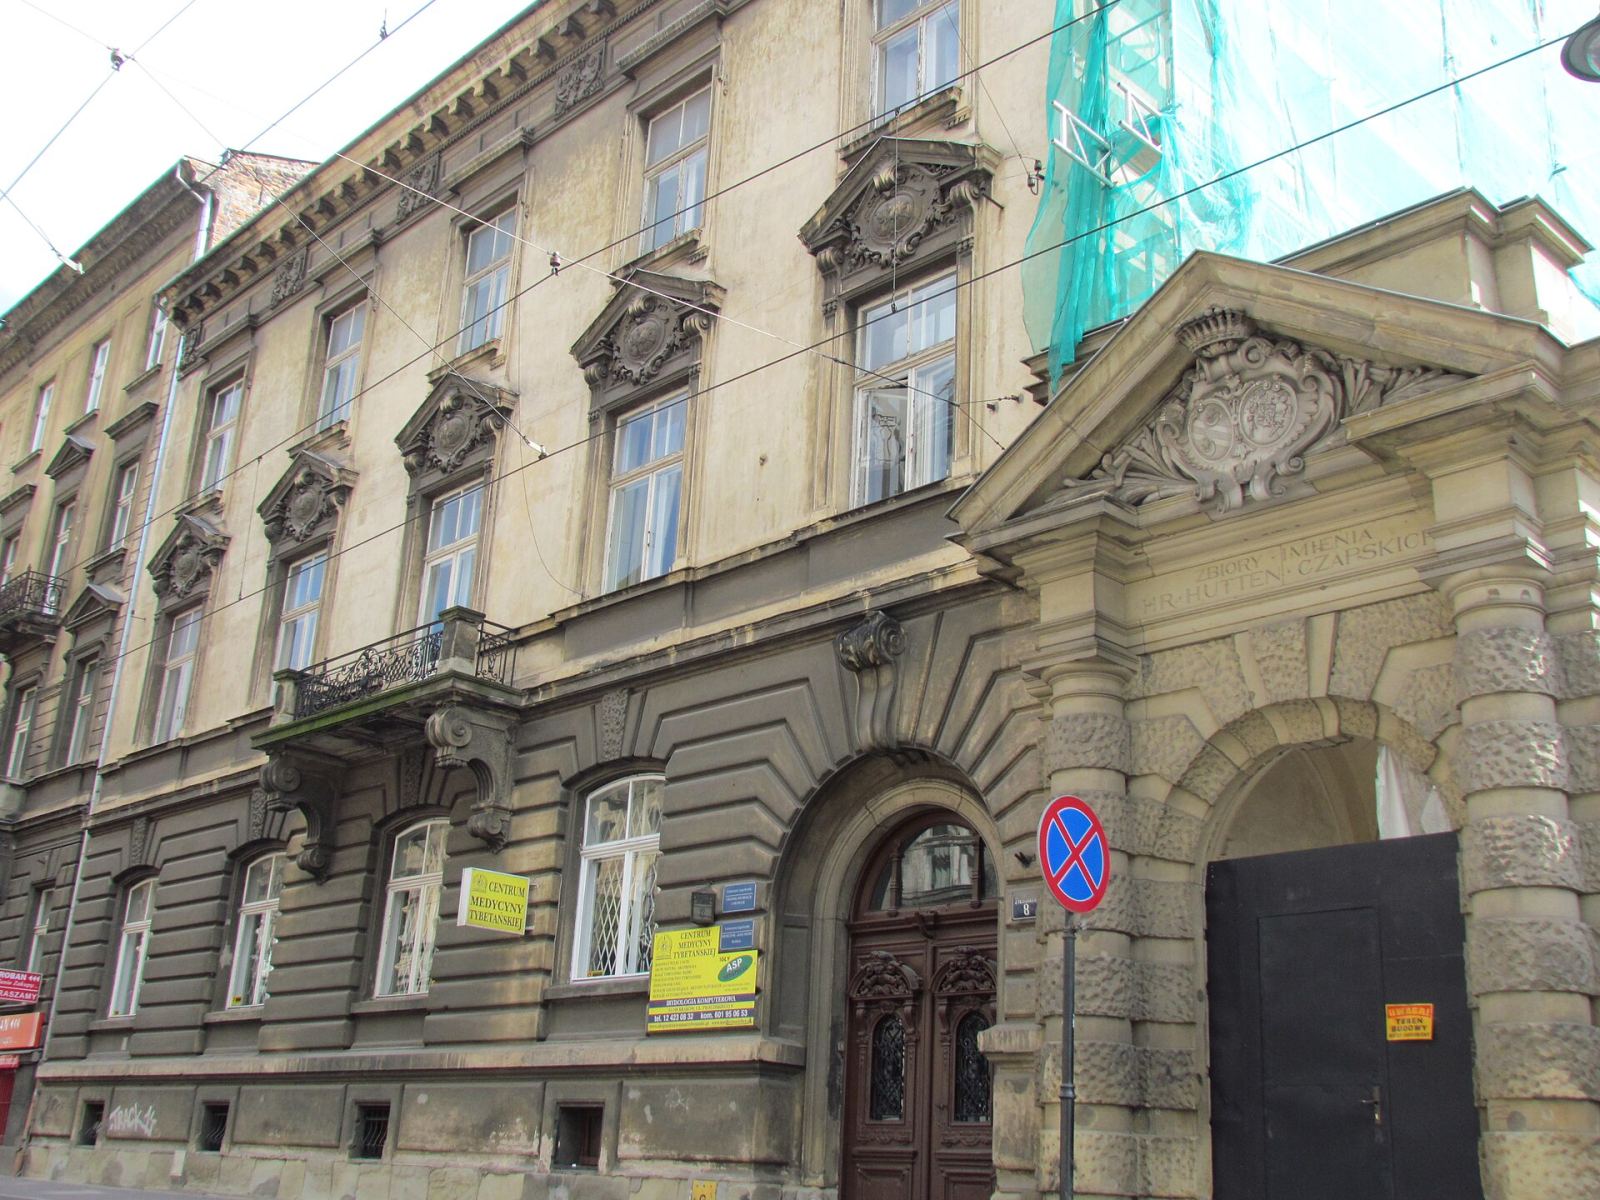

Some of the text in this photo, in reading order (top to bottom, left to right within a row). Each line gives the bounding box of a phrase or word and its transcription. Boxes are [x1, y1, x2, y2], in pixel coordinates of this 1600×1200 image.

[1201, 529, 1374, 581] ZBIORY IMIENIA
[1186, 568, 1282, 603] HUTTEN
[488, 881, 525, 897] CENTRUM
[470, 895, 524, 914] MEDYCYNY
[1023, 903, 1030, 916] 8
[680, 929, 711, 940] CENTRUM
[678, 939, 711, 949] MEDYCYNY
[726, 957, 743, 973] ASP
[697, 995, 736, 1004] KOMPUTEROWA
[740, 1009, 748, 1017] 53
[1396, 1017, 1424, 1025] TEREN
[1391, 1024, 1427, 1032] BUDOWY
